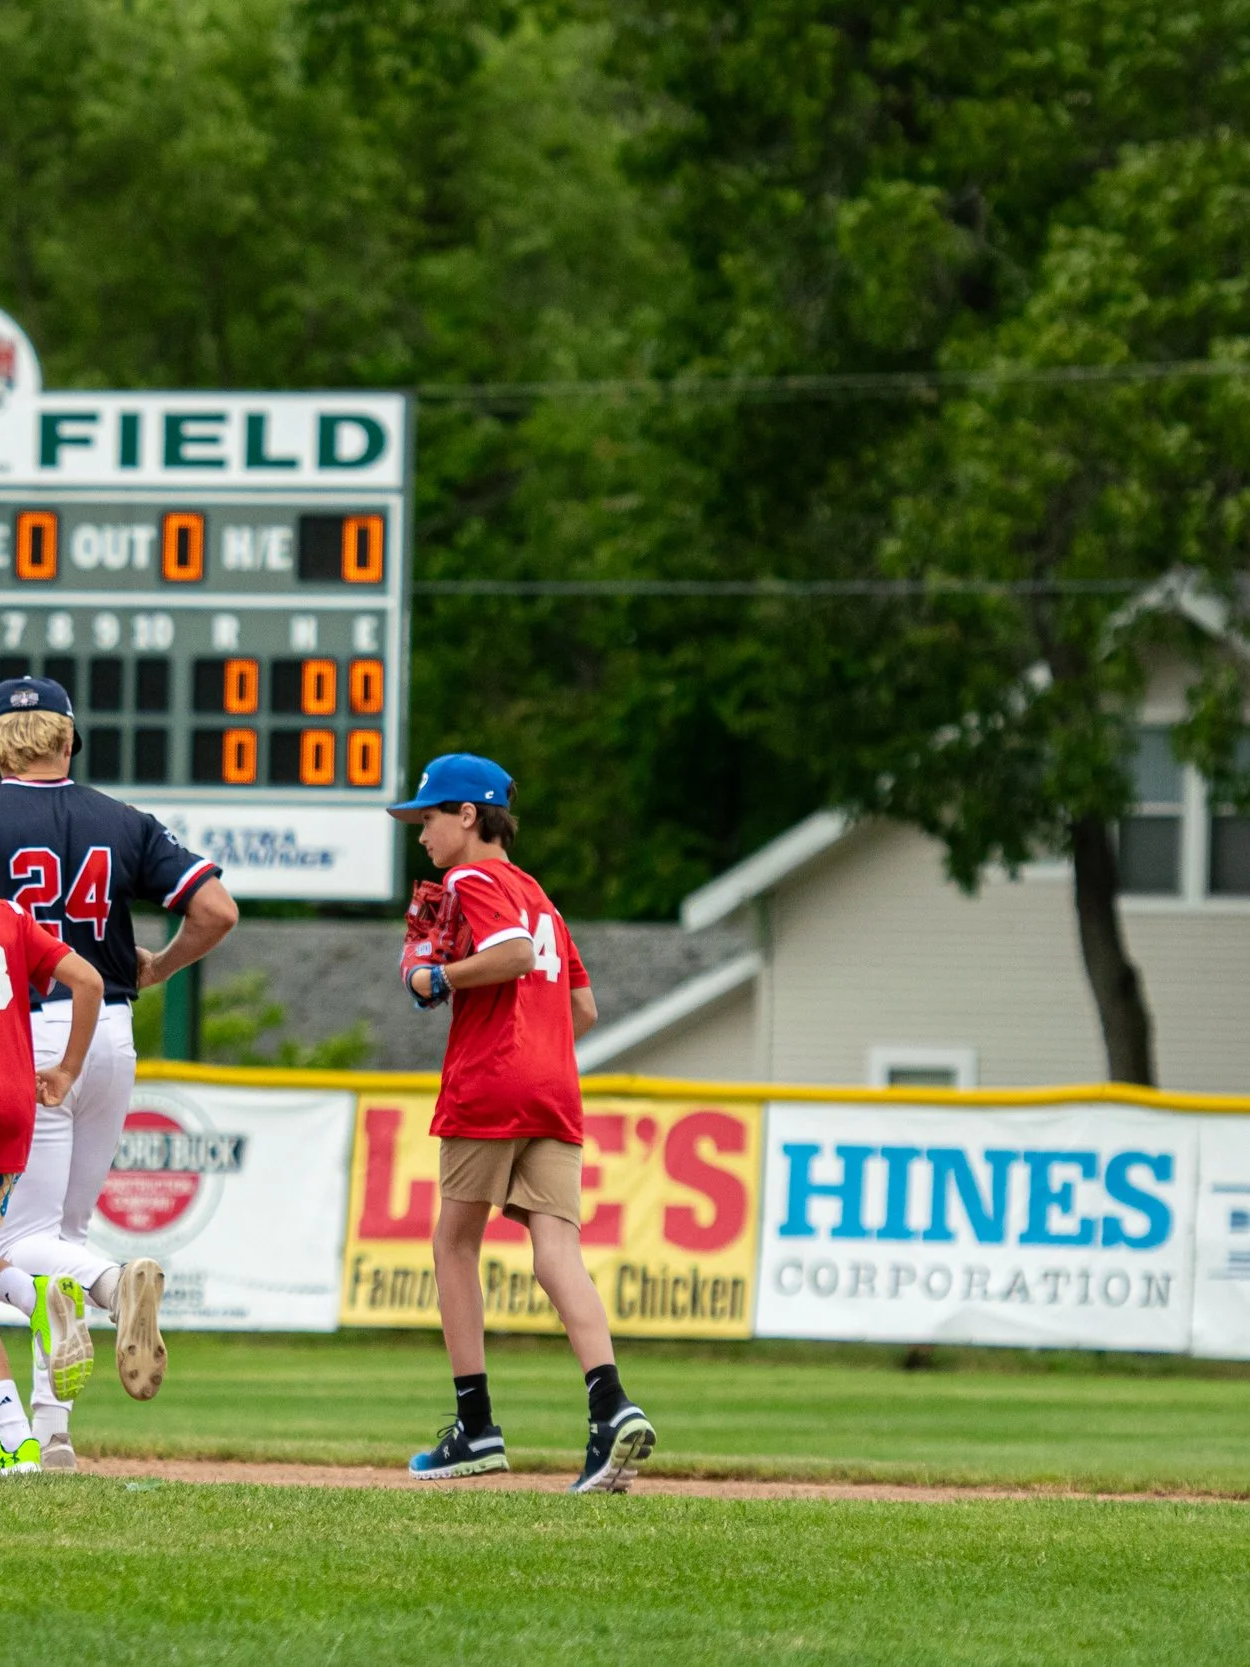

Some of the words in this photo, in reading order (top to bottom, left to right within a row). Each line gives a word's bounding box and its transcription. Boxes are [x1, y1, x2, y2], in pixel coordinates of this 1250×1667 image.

[39, 411, 386, 470] FIELD
[16, 511, 57, 580] 0
[71, 525, 156, 570] OUT
[162, 512, 205, 582] 0
[222, 527, 293, 570] H/E
[342, 514, 383, 583] 0
[2, 612, 28, 648] 7
[48, 612, 75, 649] 8
[93, 613, 120, 649] 9
[132, 613, 174, 650] 10
[212, 614, 240, 651] R
[224, 659, 259, 715] 0
[301, 659, 337, 716] 0
[349, 659, 384, 714] 0
[222, 728, 257, 784] 0
[300, 729, 336, 785] 0
[347, 729, 382, 786] 0
[10, 846, 112, 941] 24
[520, 908, 561, 983] 4
[170, 1131, 243, 1173] BUCK
[358, 1108, 749, 1255] LE'S
[778, 1141, 1175, 1251] HINES
[615, 1262, 747, 1323] Chicken
[773, 1256, 1174, 1309] CORPORATION
